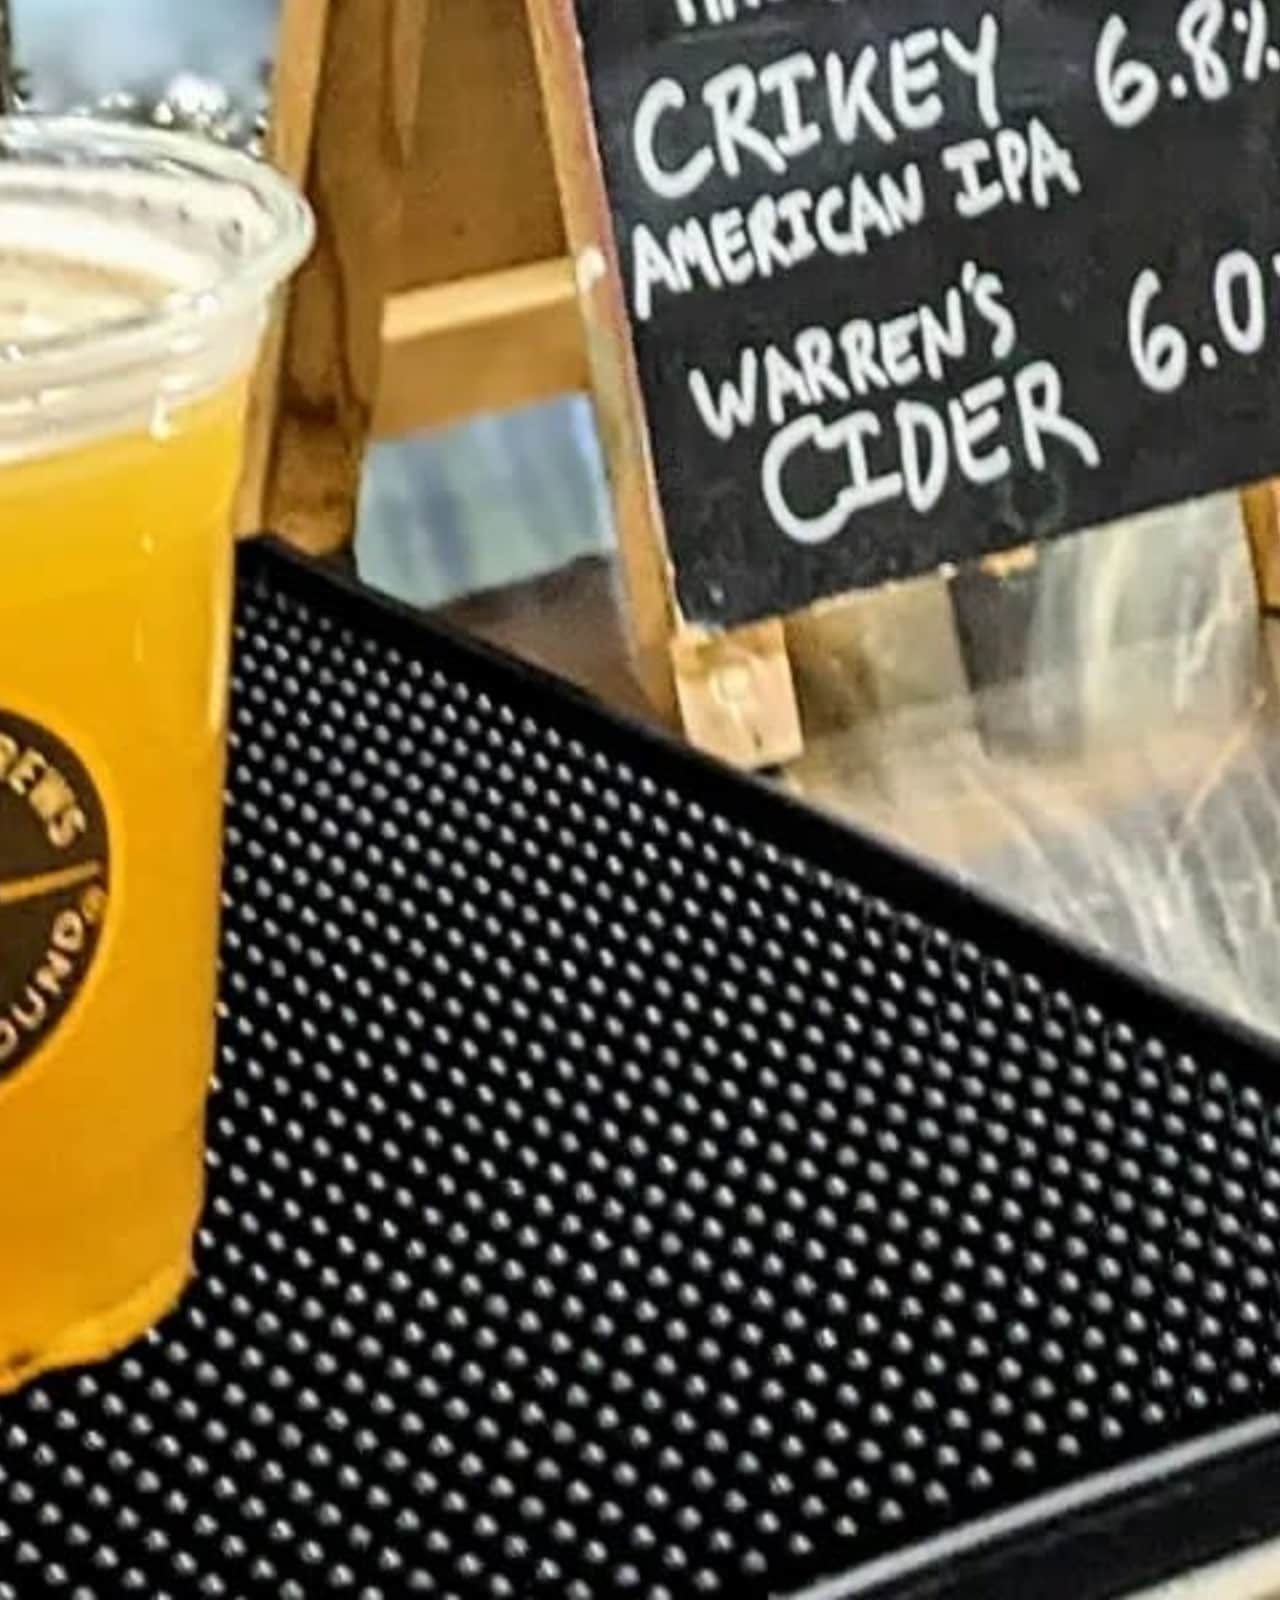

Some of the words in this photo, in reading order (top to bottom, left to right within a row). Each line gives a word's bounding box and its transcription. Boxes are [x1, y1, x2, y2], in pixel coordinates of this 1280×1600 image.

[632, 13, 1003, 198] CRIKEY
[630, 161, 923, 320] AMERICAN
[942, 117, 1082, 218] IPA
[688, 261, 1018, 440] WARREN'S
[761, 359, 1101, 544] CIDER
